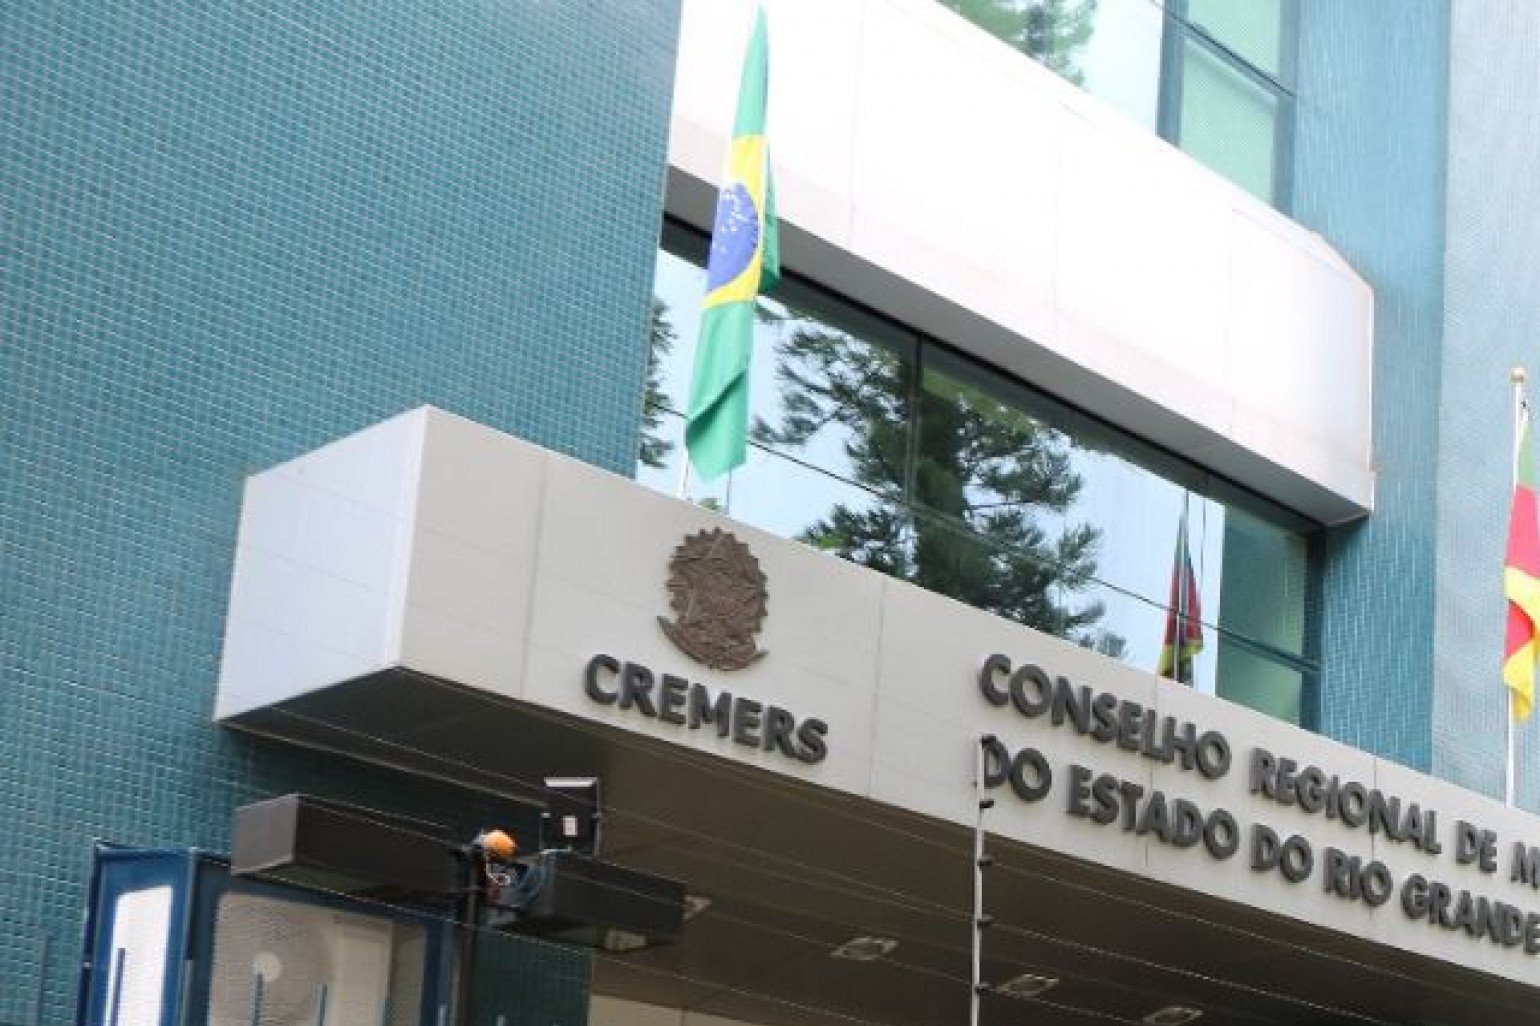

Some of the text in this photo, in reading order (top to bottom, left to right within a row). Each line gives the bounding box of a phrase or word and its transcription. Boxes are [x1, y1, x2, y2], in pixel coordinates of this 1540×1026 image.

[583, 654, 828, 765] CREMERS
[979, 653, 1232, 781] CONSELHO
[1248, 748, 1442, 855] REGIONAL
[1455, 820, 1498, 873] DE
[981, 734, 1052, 802] DO
[1065, 764, 1240, 860] ESTADO
[1250, 823, 1314, 883] DO
[1323, 846, 1393, 907] RIO
